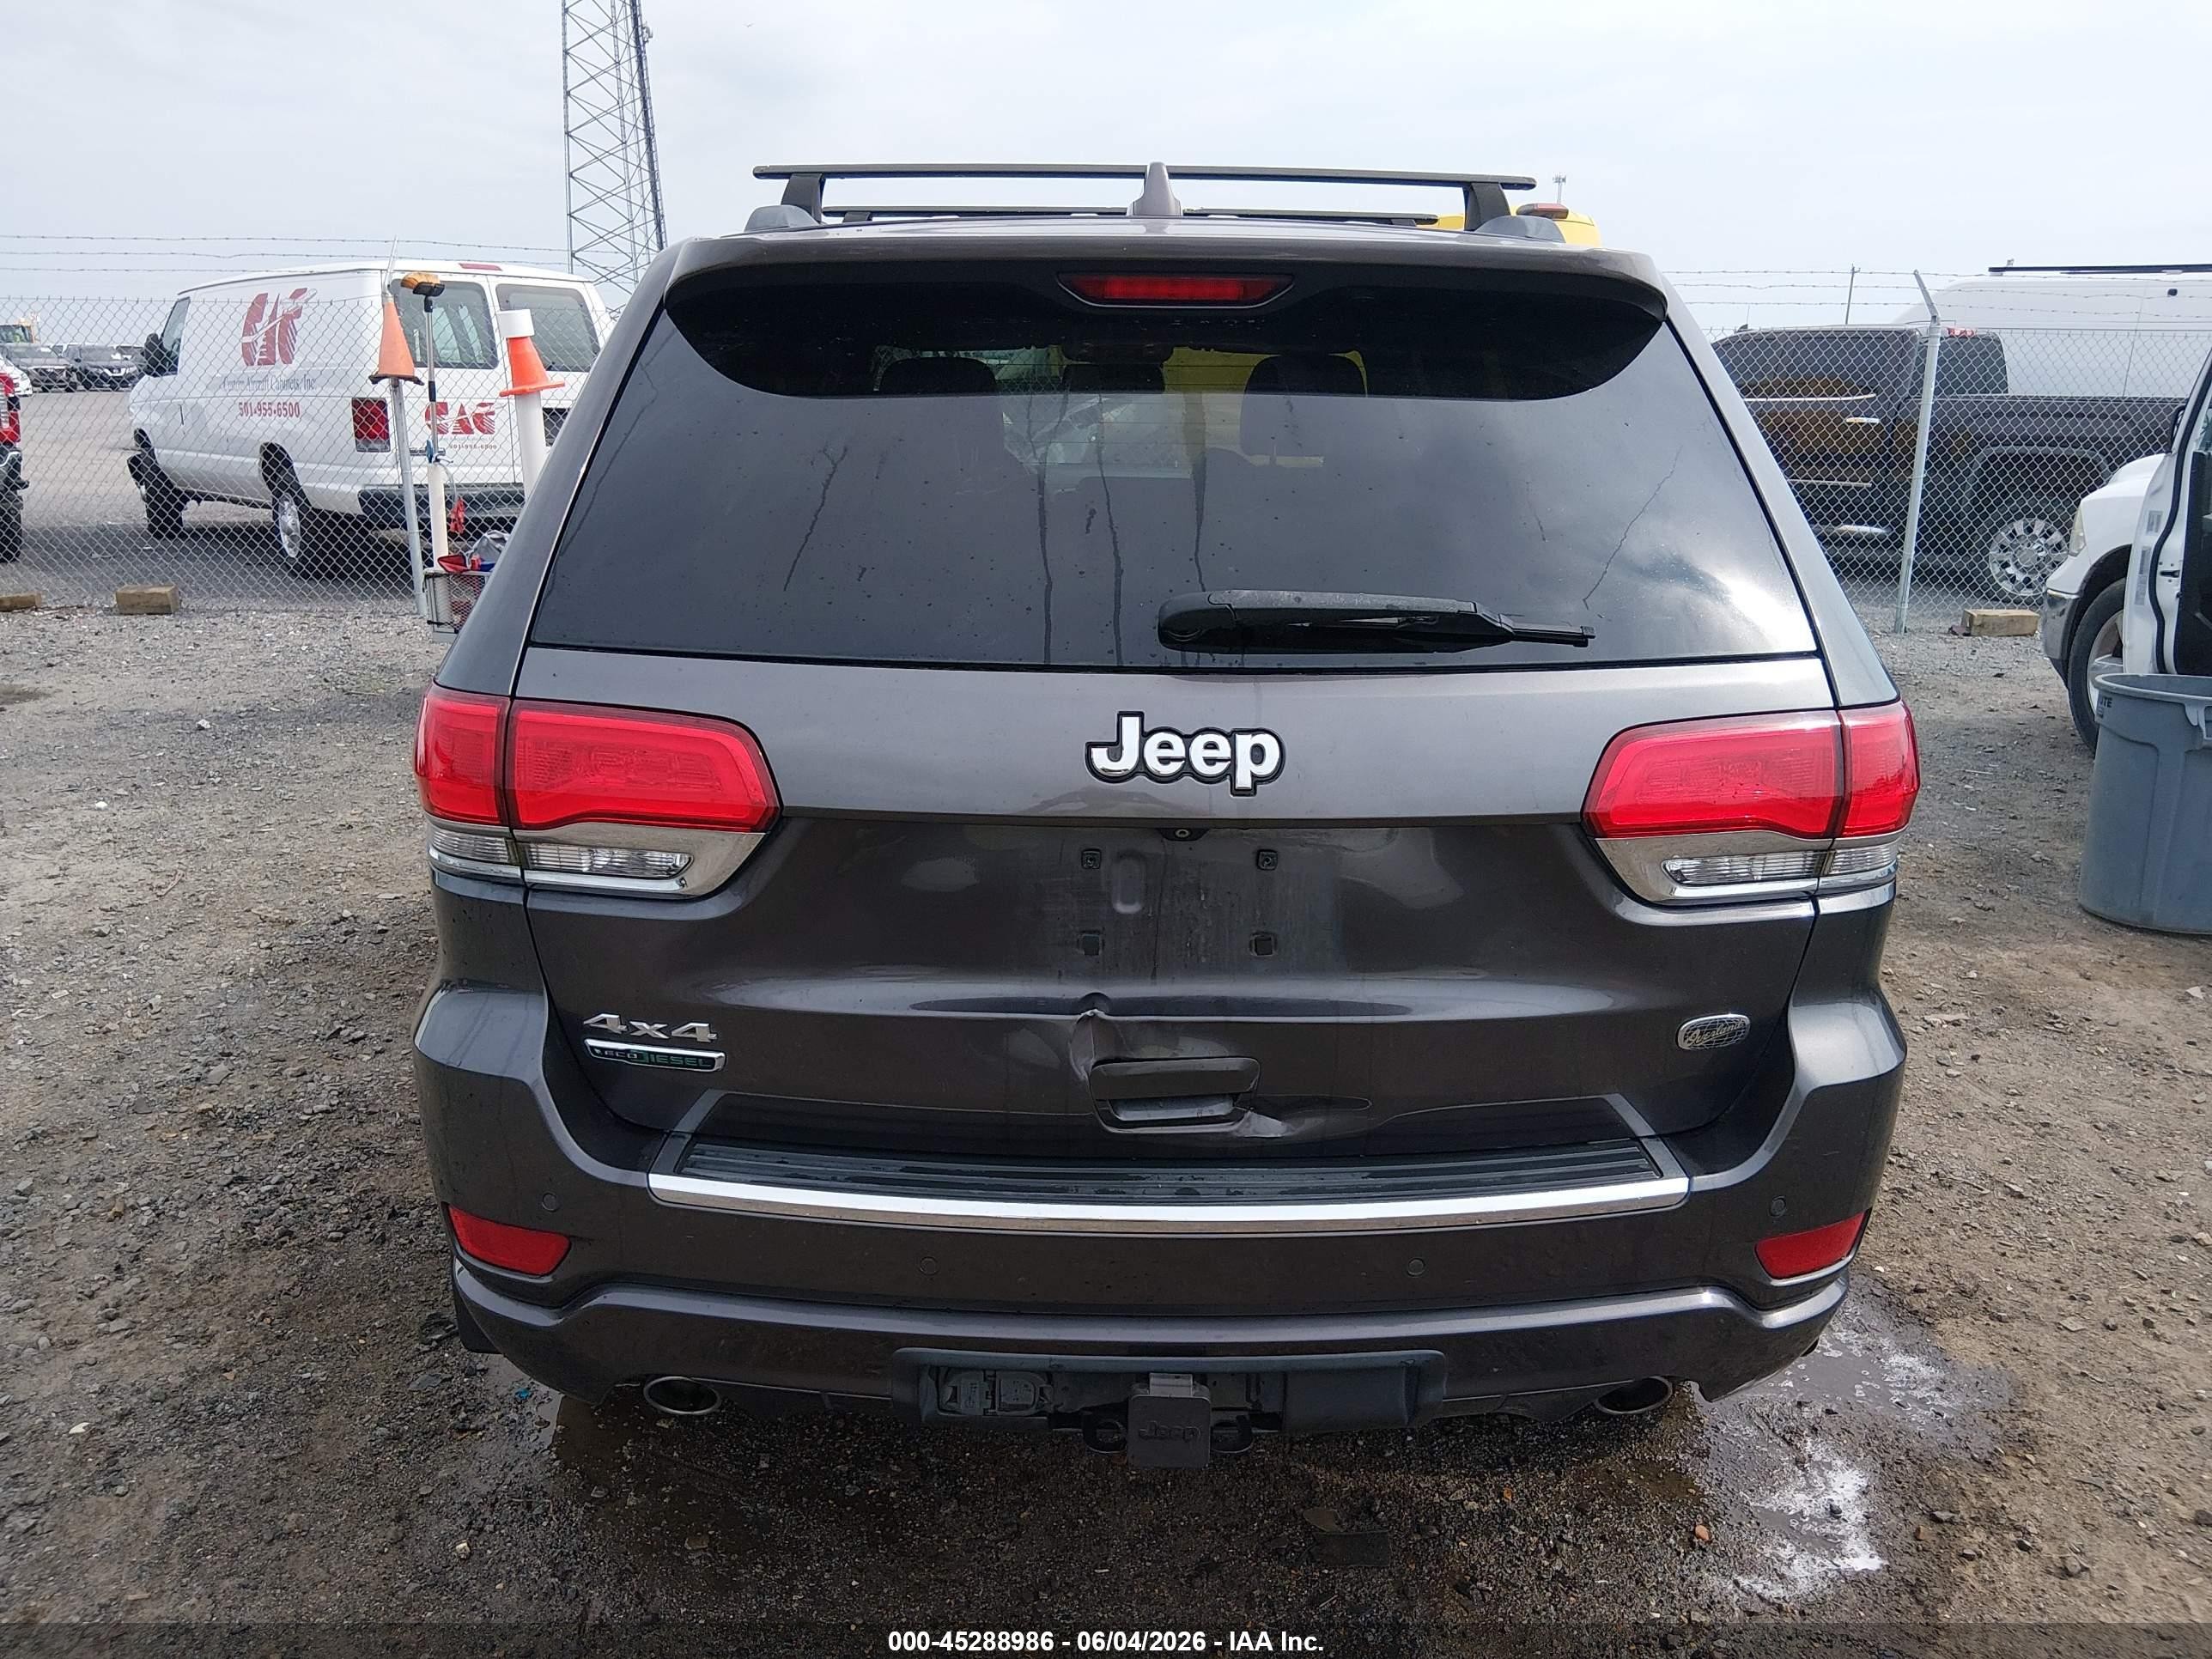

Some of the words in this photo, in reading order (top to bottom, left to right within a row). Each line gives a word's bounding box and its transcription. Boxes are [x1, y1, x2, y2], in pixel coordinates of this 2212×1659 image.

[239, 402, 301, 417] 501-955-6500
[1087, 714, 1283, 793] Jeep
[1138, 1420, 1201, 1443] Jeep
